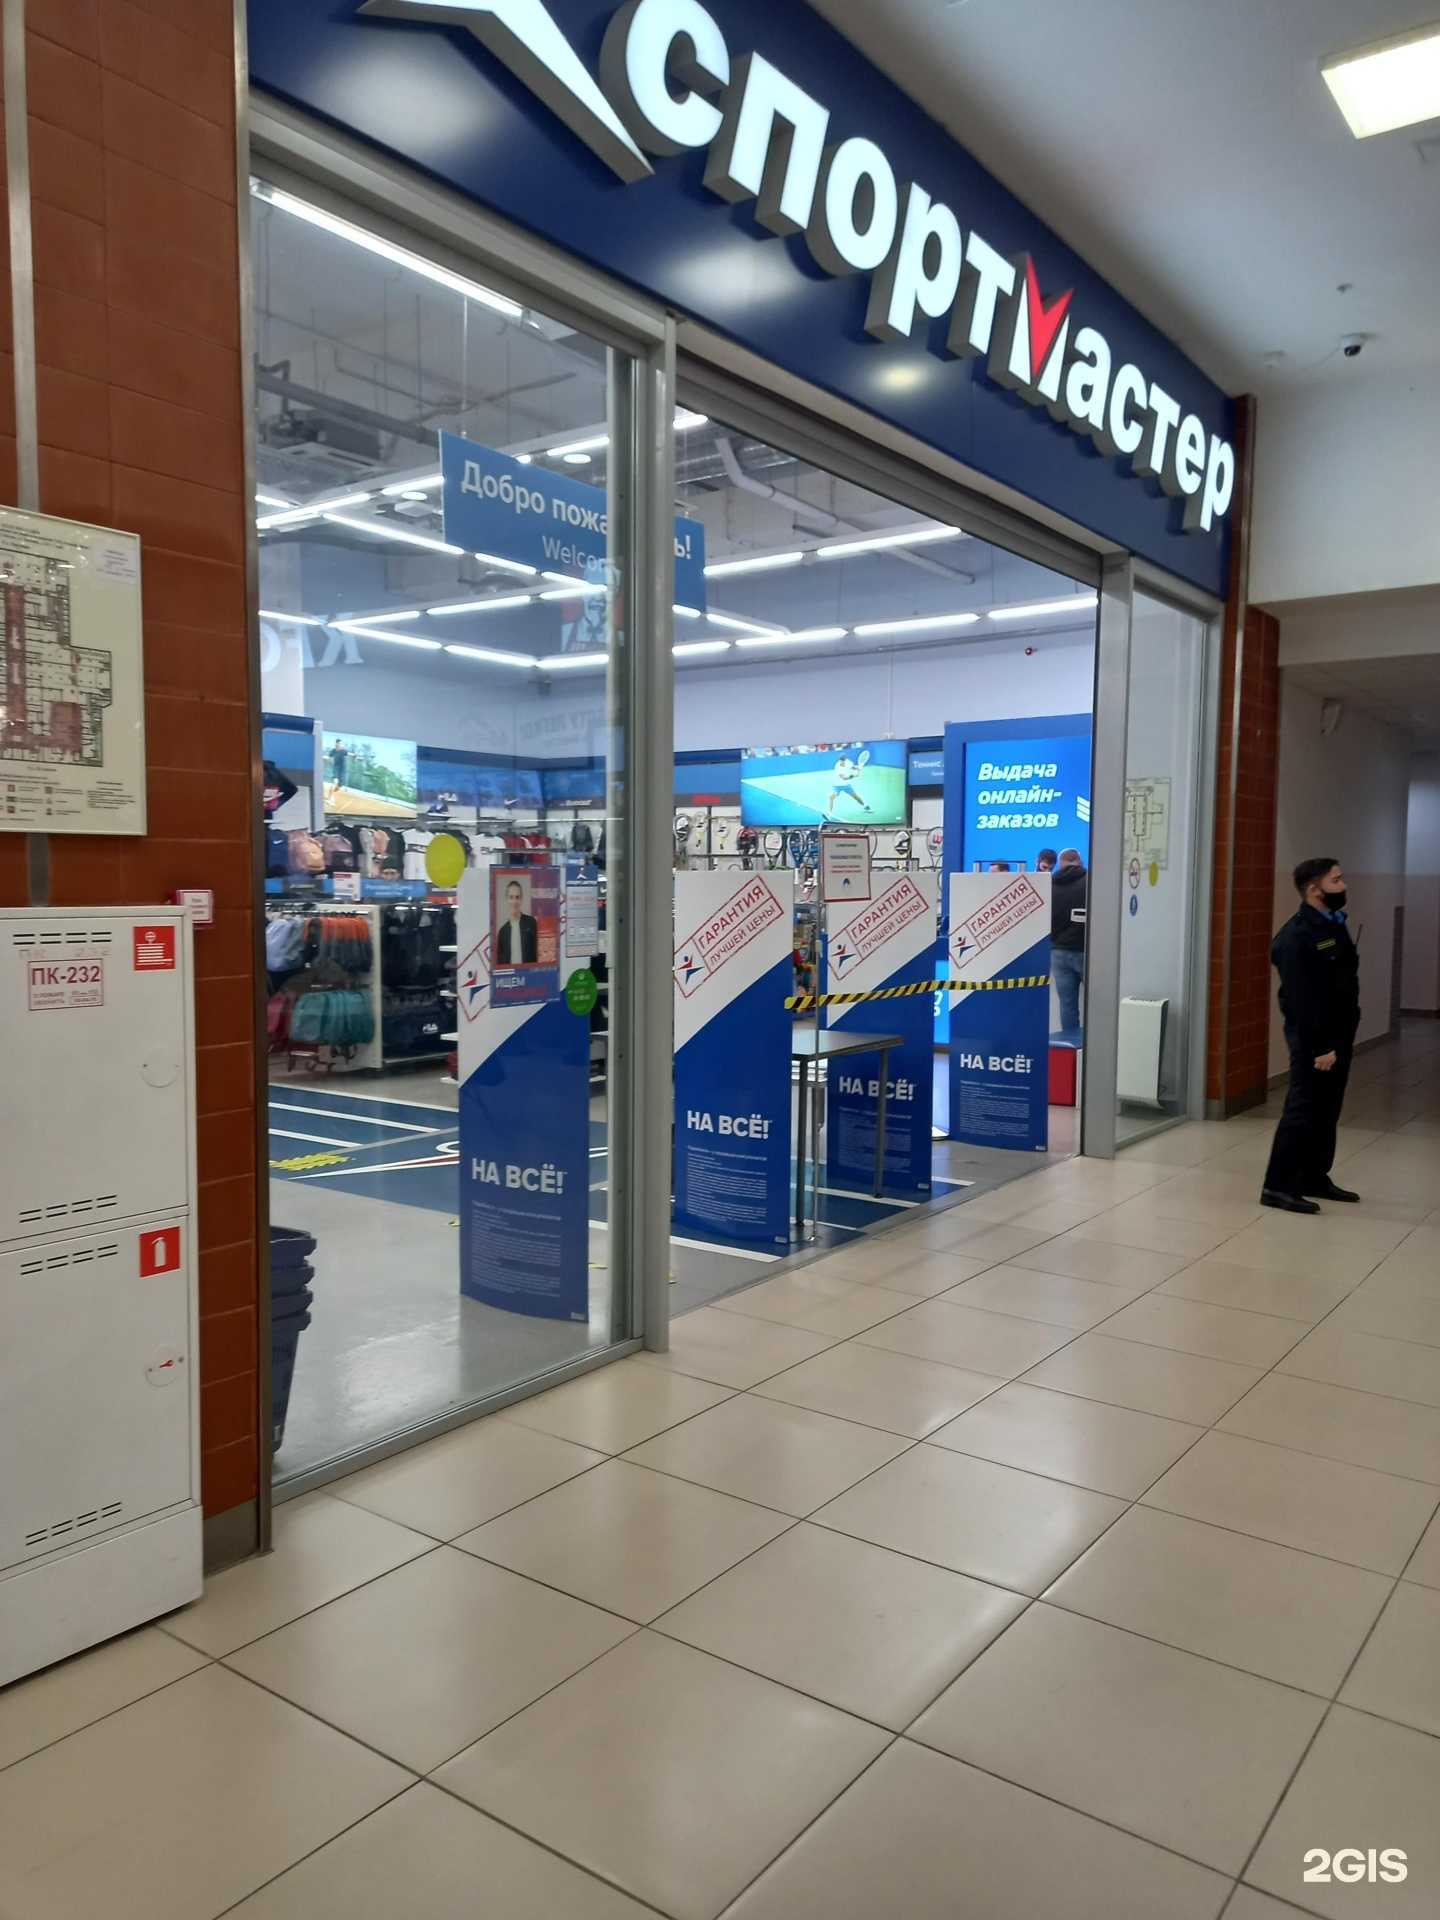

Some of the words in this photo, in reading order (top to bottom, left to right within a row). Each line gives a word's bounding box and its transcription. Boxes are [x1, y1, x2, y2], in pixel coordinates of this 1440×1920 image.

[460, 460, 546, 514] Добро
[977, 762, 1058, 782] Выдача
[977, 785, 1063, 805] онлайн-
[976, 813, 1059, 829] заказов
[698, 886, 765, 949] ГАРАНТИЯ
[851, 884, 912, 938] ГАРАНТИЯ
[971, 883, 1028, 932] ГАРАНТИЯ
[982, 917, 1012, 943] ЛУЧШЕЙ
[1013, 897, 1037, 918] ЦЕНЫ
[711, 930, 746, 964] ЛУЧШЕЙ
[747, 906, 776, 932] ЦЕНЫ
[862, 922, 895, 952] ЛУЧШЕЙ
[896, 901, 922, 923] ЦЕНЫ
[31, 965, 101, 987] ПК-232
[959, 1053, 985, 1071] НА
[988, 1055, 1032, 1074] ВСЁ!
[839, 1076, 864, 1095] НА
[687, 1110, 713, 1133] НА
[718, 1113, 769, 1139] ВСЁ!
[472, 1158, 501, 1185] НА
[505, 1163, 564, 1195] ВСЁ!
